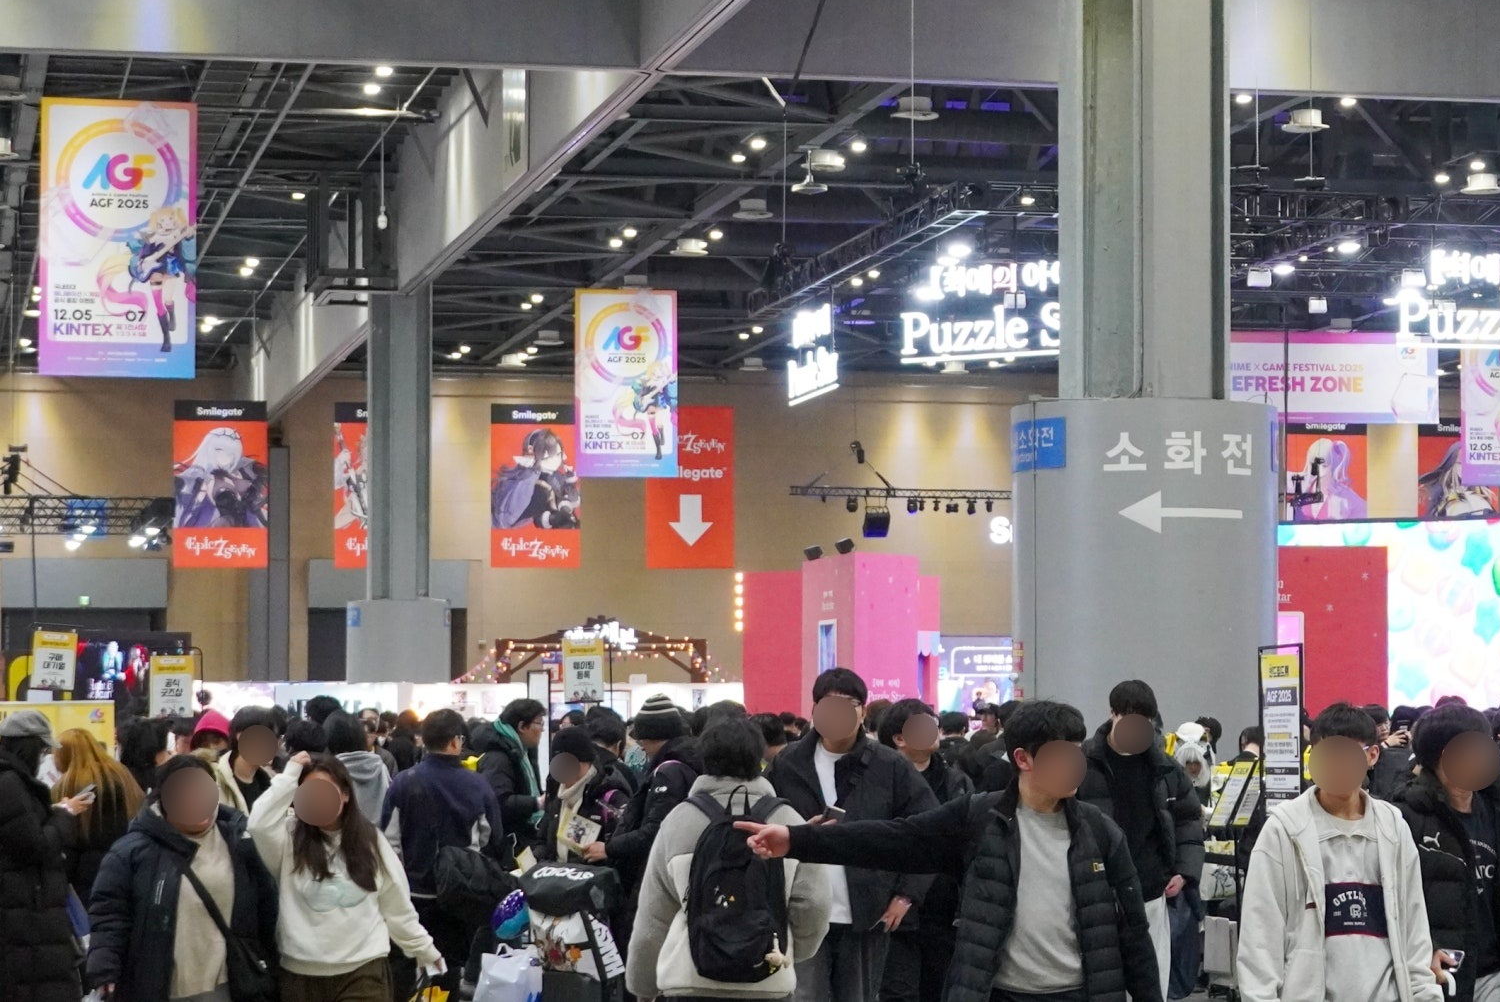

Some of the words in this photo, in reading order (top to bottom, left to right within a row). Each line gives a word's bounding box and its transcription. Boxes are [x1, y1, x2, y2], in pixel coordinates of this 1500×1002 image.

[82, 153, 157, 191] AGF
[89, 198, 114, 208] AGF
[117, 198, 149, 209] 2025
[54, 309, 92, 321] 12.05
[125, 310, 146, 322] 07
[53, 323, 113, 336] KINTEX
[900, 304, 1029, 355] Puzzle
[602, 325, 649, 351] AGF
[625, 356, 647, 364] 2025
[1230, 363, 1252, 372] NIME
[1293, 363, 1336, 372] FESTIVAL
[1339, 364, 1364, 372] 2025
[1232, 376, 1305, 393] EFRESH
[1310, 376, 1364, 393] ZONE
[197, 406, 243, 417] Smilegate
[512, 410, 557, 421] Smilegate
[585, 431, 610, 440] 12.05
[631, 432, 645, 440] 07
[1014, 426, 1054, 449] 소화전
[584, 440, 624, 450] KINTEX
[1469, 443, 1492, 451] 12.05
[1266, 690, 1278, 703] AGF
[1278, 689, 1292, 703] 2025
